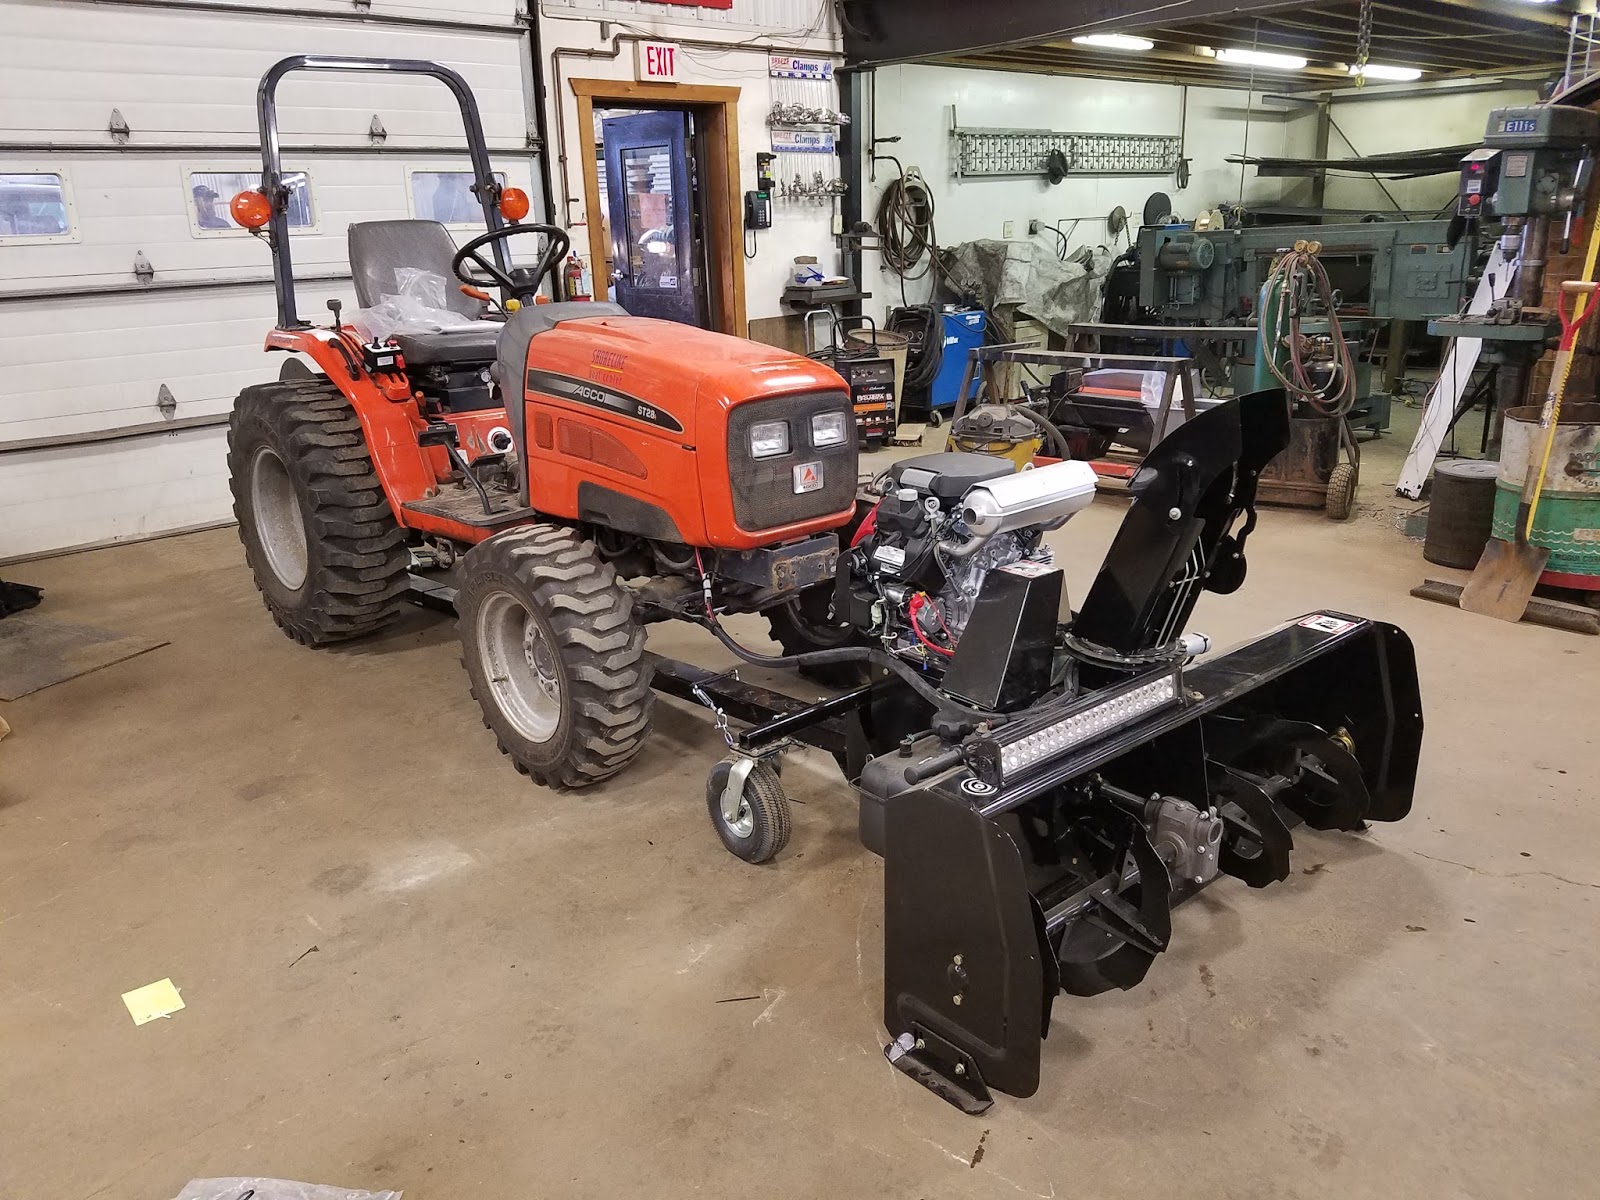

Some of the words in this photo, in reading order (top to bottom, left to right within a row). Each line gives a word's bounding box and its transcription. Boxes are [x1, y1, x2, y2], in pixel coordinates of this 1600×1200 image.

[646, 45, 675, 77] EXIT
[771, 57, 790, 65] BREEZE
[792, 60, 819, 73] Clamps
[1506, 120, 1536, 132] Ellis
[794, 134, 820, 146] Clamps
[591, 349, 628, 370] SHORELINE
[573, 385, 605, 403] AGCO
